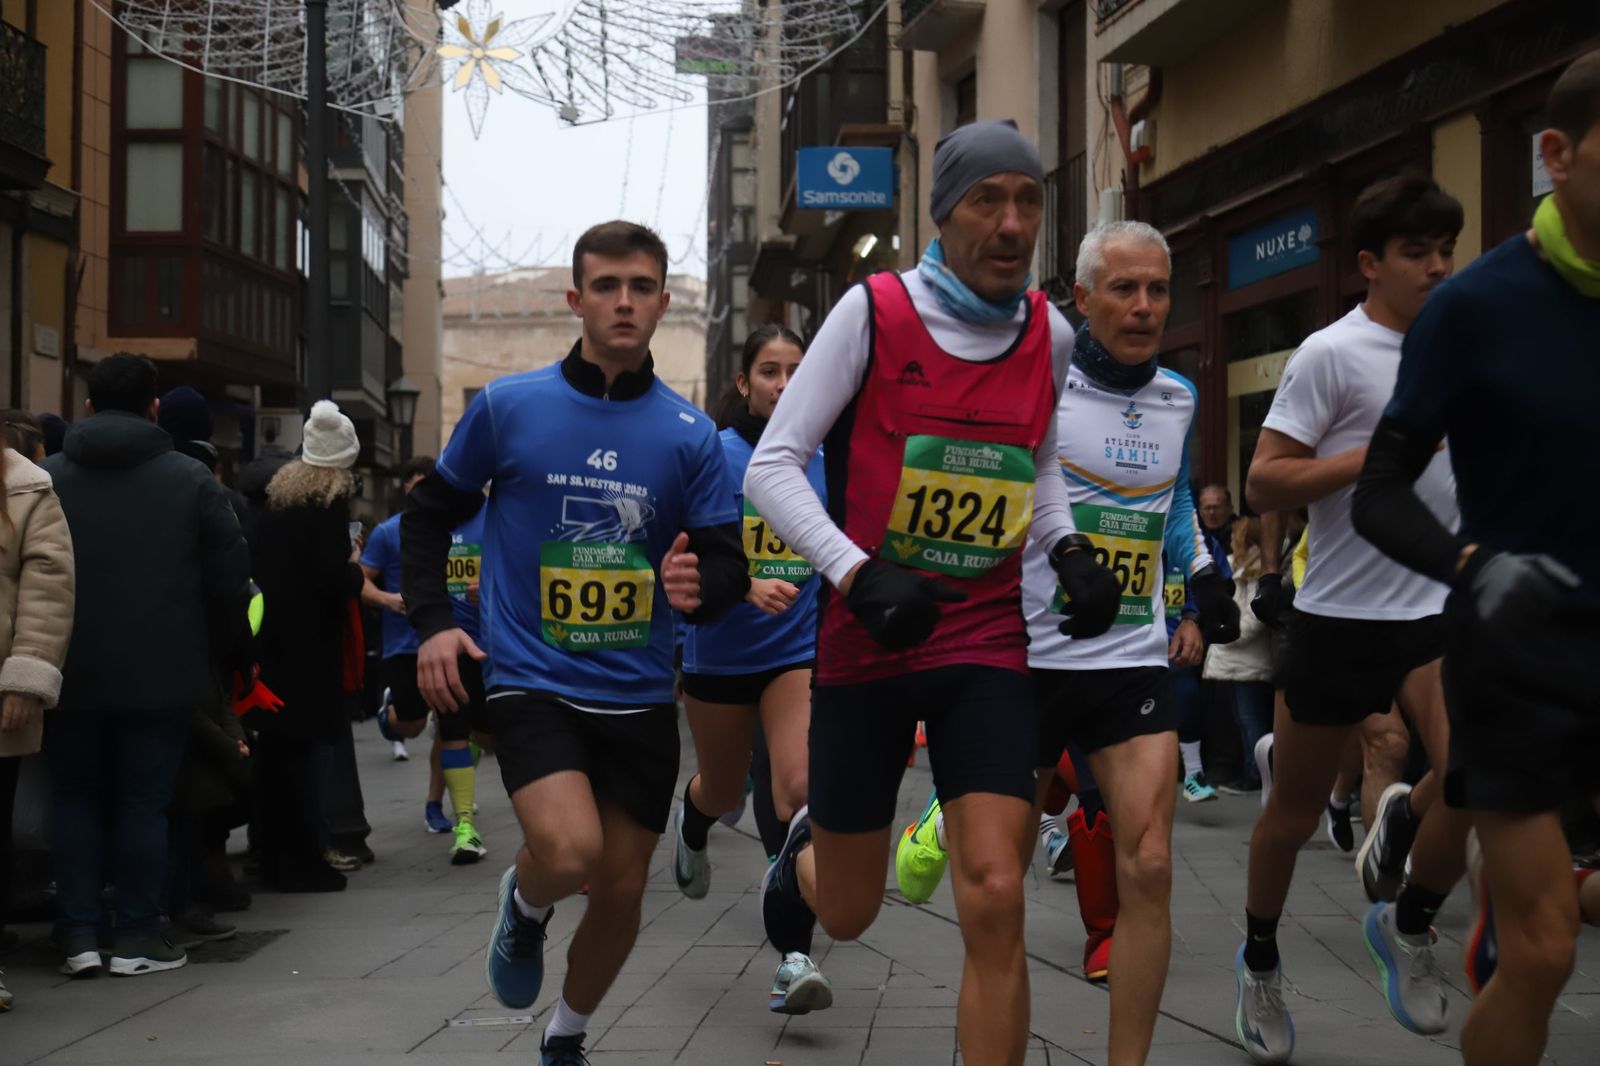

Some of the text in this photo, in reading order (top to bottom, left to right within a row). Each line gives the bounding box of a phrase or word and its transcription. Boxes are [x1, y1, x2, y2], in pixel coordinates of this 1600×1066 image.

[803, 190, 887, 204] Samsonite
[1256, 230, 1296, 260] NUXE
[1105, 438, 1160, 451] ATLETISMO
[586, 448, 618, 471] 46
[943, 455, 967, 466] CAJA
[968, 458, 1002, 470] RURAL
[1105, 446, 1159, 465] SAMIL
[546, 473, 648, 497] SAN SILVESTRE 2025
[907, 485, 1007, 547] 1324
[1099, 520, 1119, 529] CAJA
[1121, 523, 1148, 533] RURAL
[750, 521, 798, 555] 13
[572, 555, 625, 564] CAJA RURAL
[922, 548, 960, 566] CAJA
[762, 565, 785, 575] CAJA
[549, 579, 637, 622] 693
[1119, 604, 1149, 616] RURAL
[569, 628, 642, 643] CAJA RURAL
